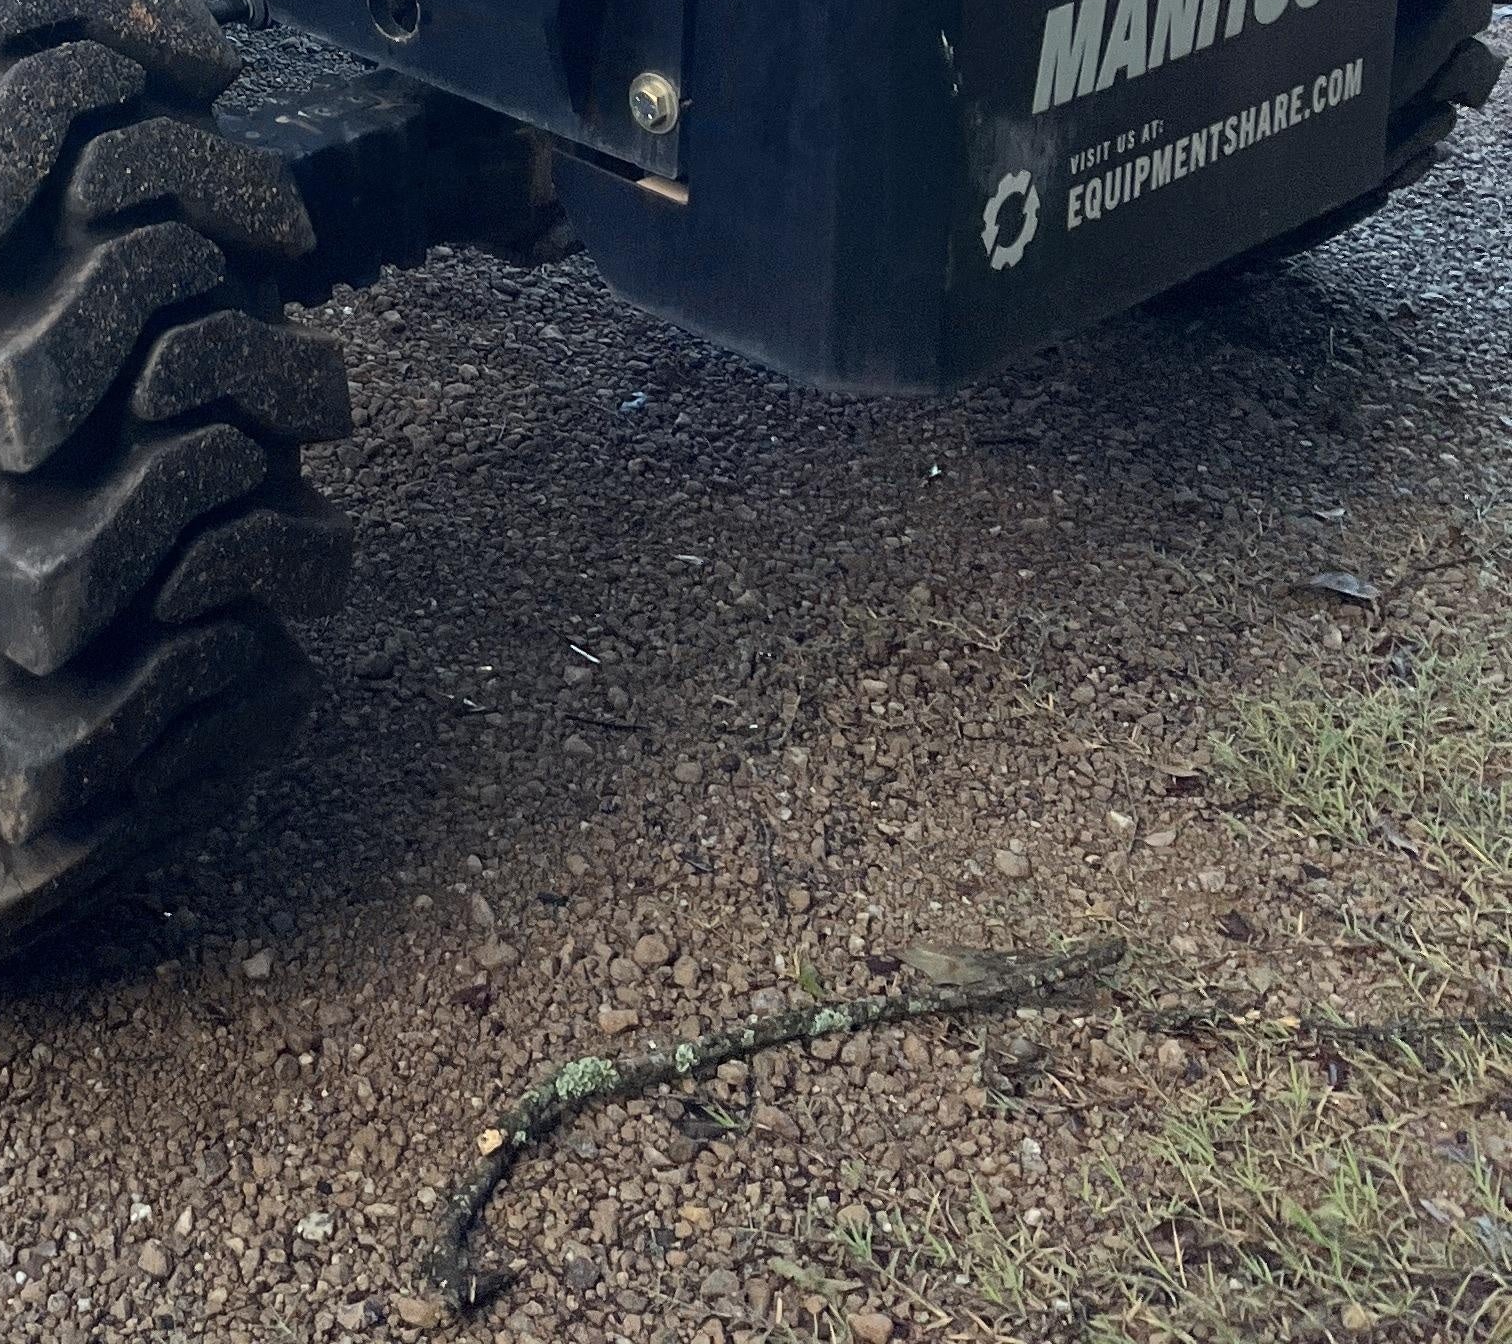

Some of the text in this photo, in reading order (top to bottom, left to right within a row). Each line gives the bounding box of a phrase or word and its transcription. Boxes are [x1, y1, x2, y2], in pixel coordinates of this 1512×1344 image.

[1066, 58, 1364, 231] EQUIPMENTSHARE.COM
[1070, 118, 1165, 175] VISIT US AT:
